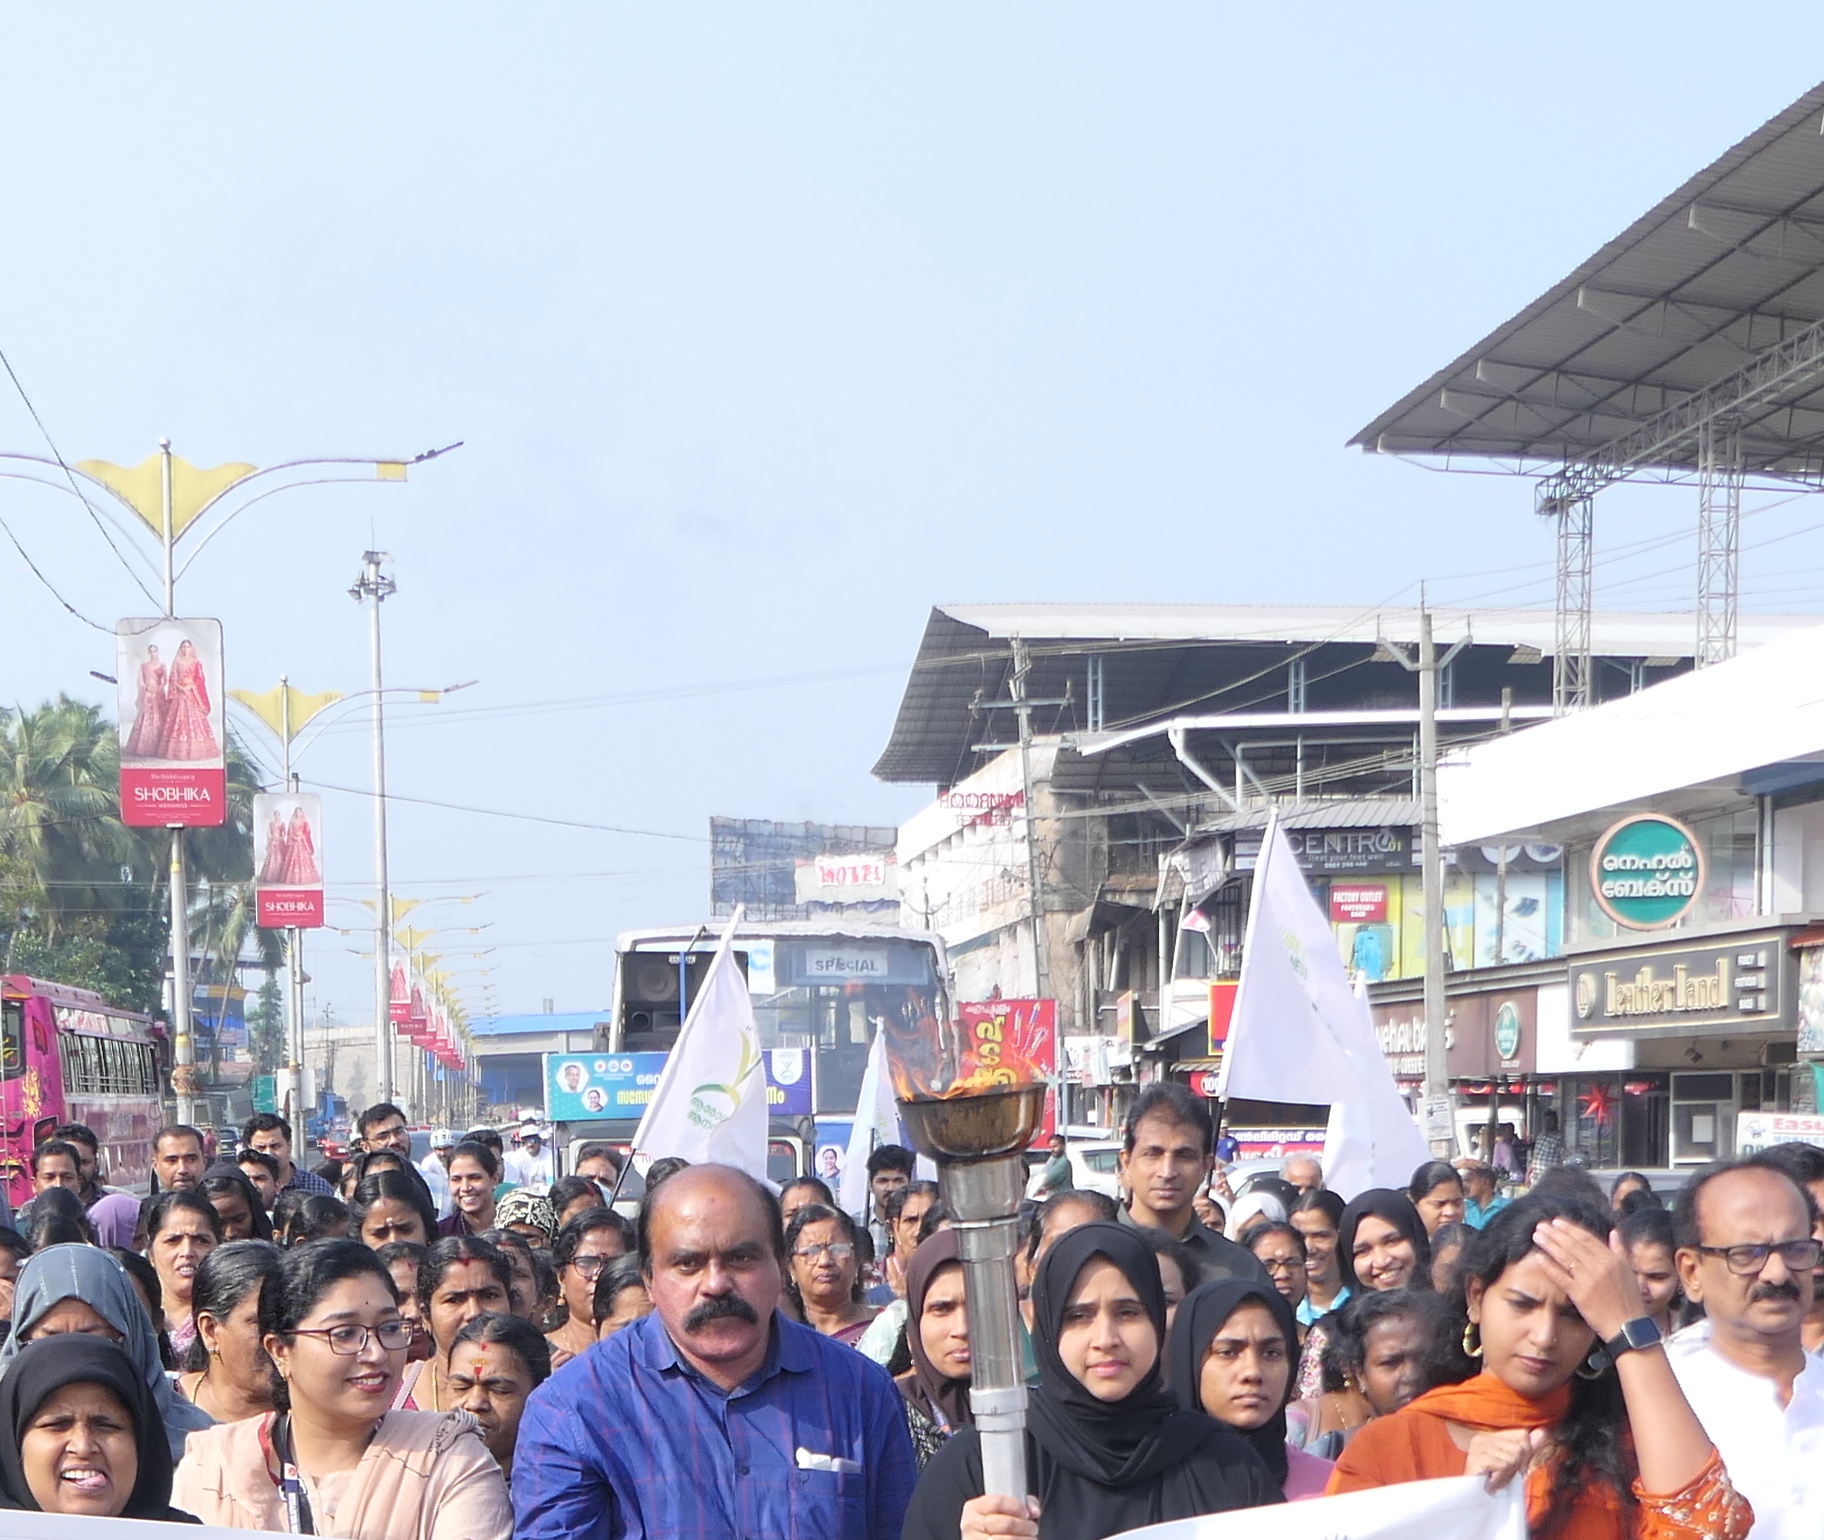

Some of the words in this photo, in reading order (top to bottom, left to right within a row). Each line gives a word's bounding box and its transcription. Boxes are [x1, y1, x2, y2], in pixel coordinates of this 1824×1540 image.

[134, 787, 210, 801] SHOBHIKA
[266, 902, 315, 911] SHOBHIKA
[816, 957, 878, 971] SPECIAL
[1604, 966, 1676, 1016] Leather
[1674, 958, 1729, 1010] Land
